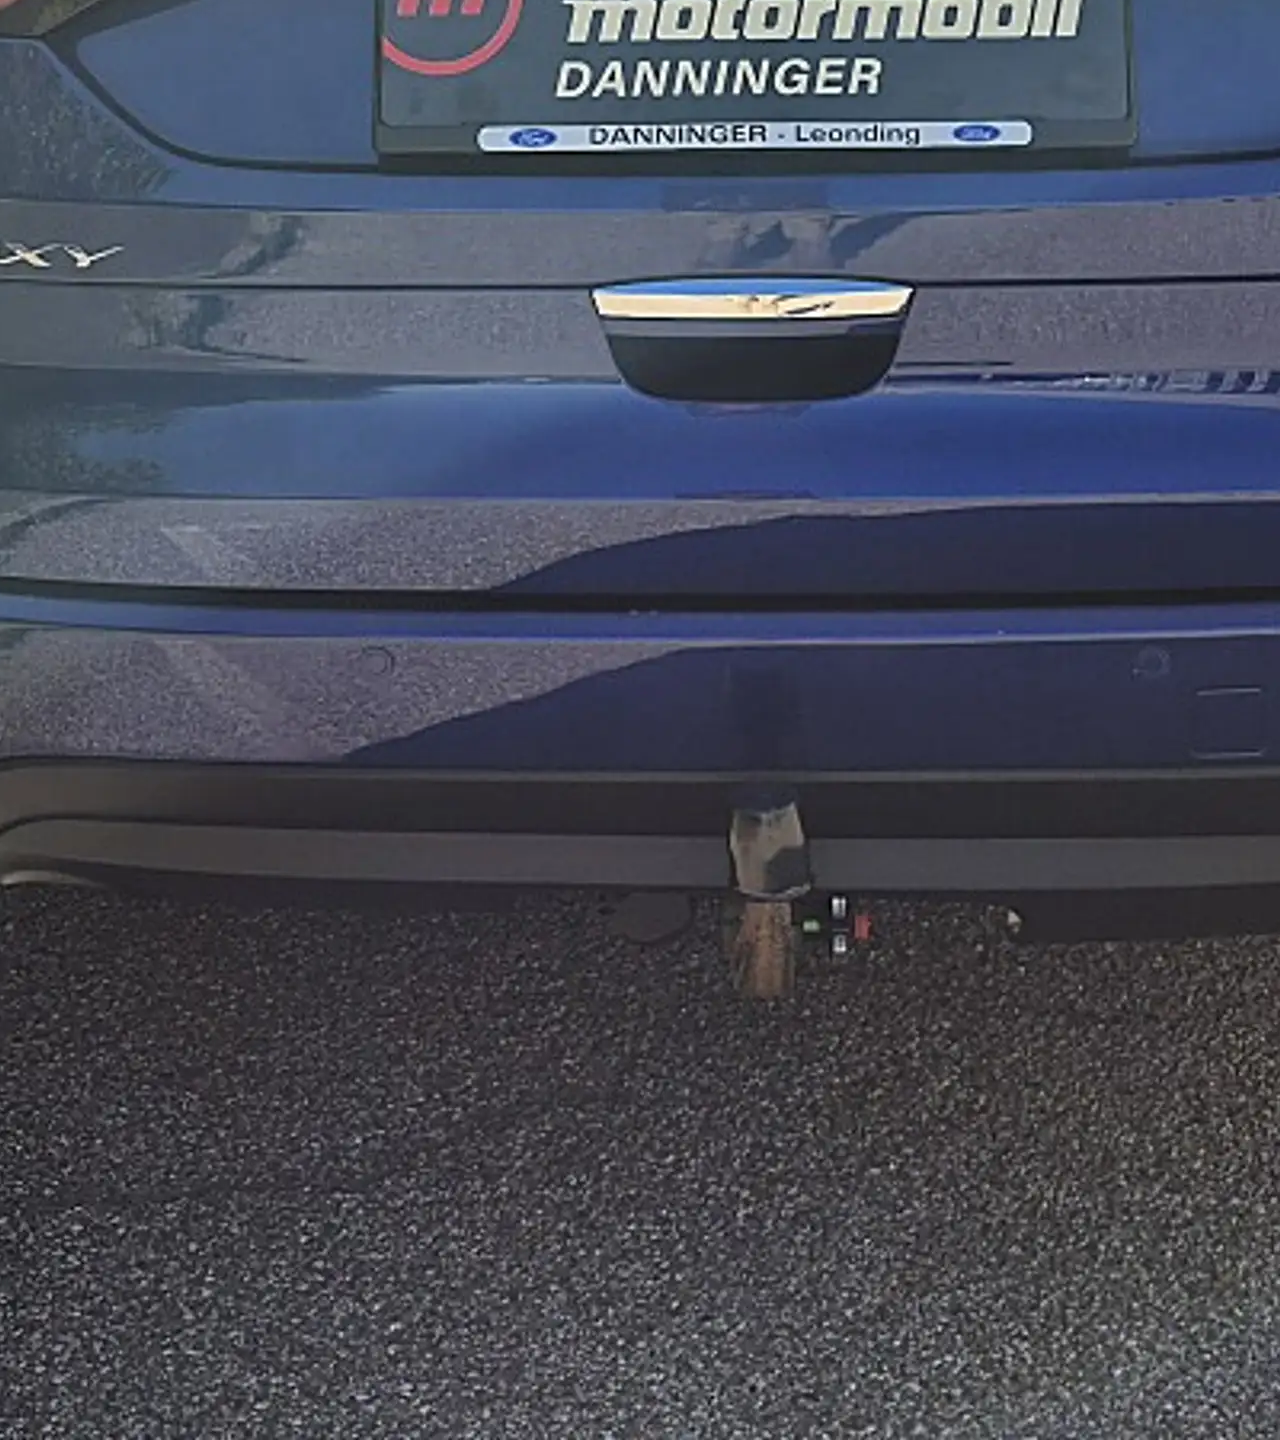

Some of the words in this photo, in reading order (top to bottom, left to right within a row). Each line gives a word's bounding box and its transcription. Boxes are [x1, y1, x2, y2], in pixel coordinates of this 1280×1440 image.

[555, 58, 882, 98] DANNINGER
[589, 124, 768, 145] DANNINGER
[796, 123, 921, 145] Leonding
